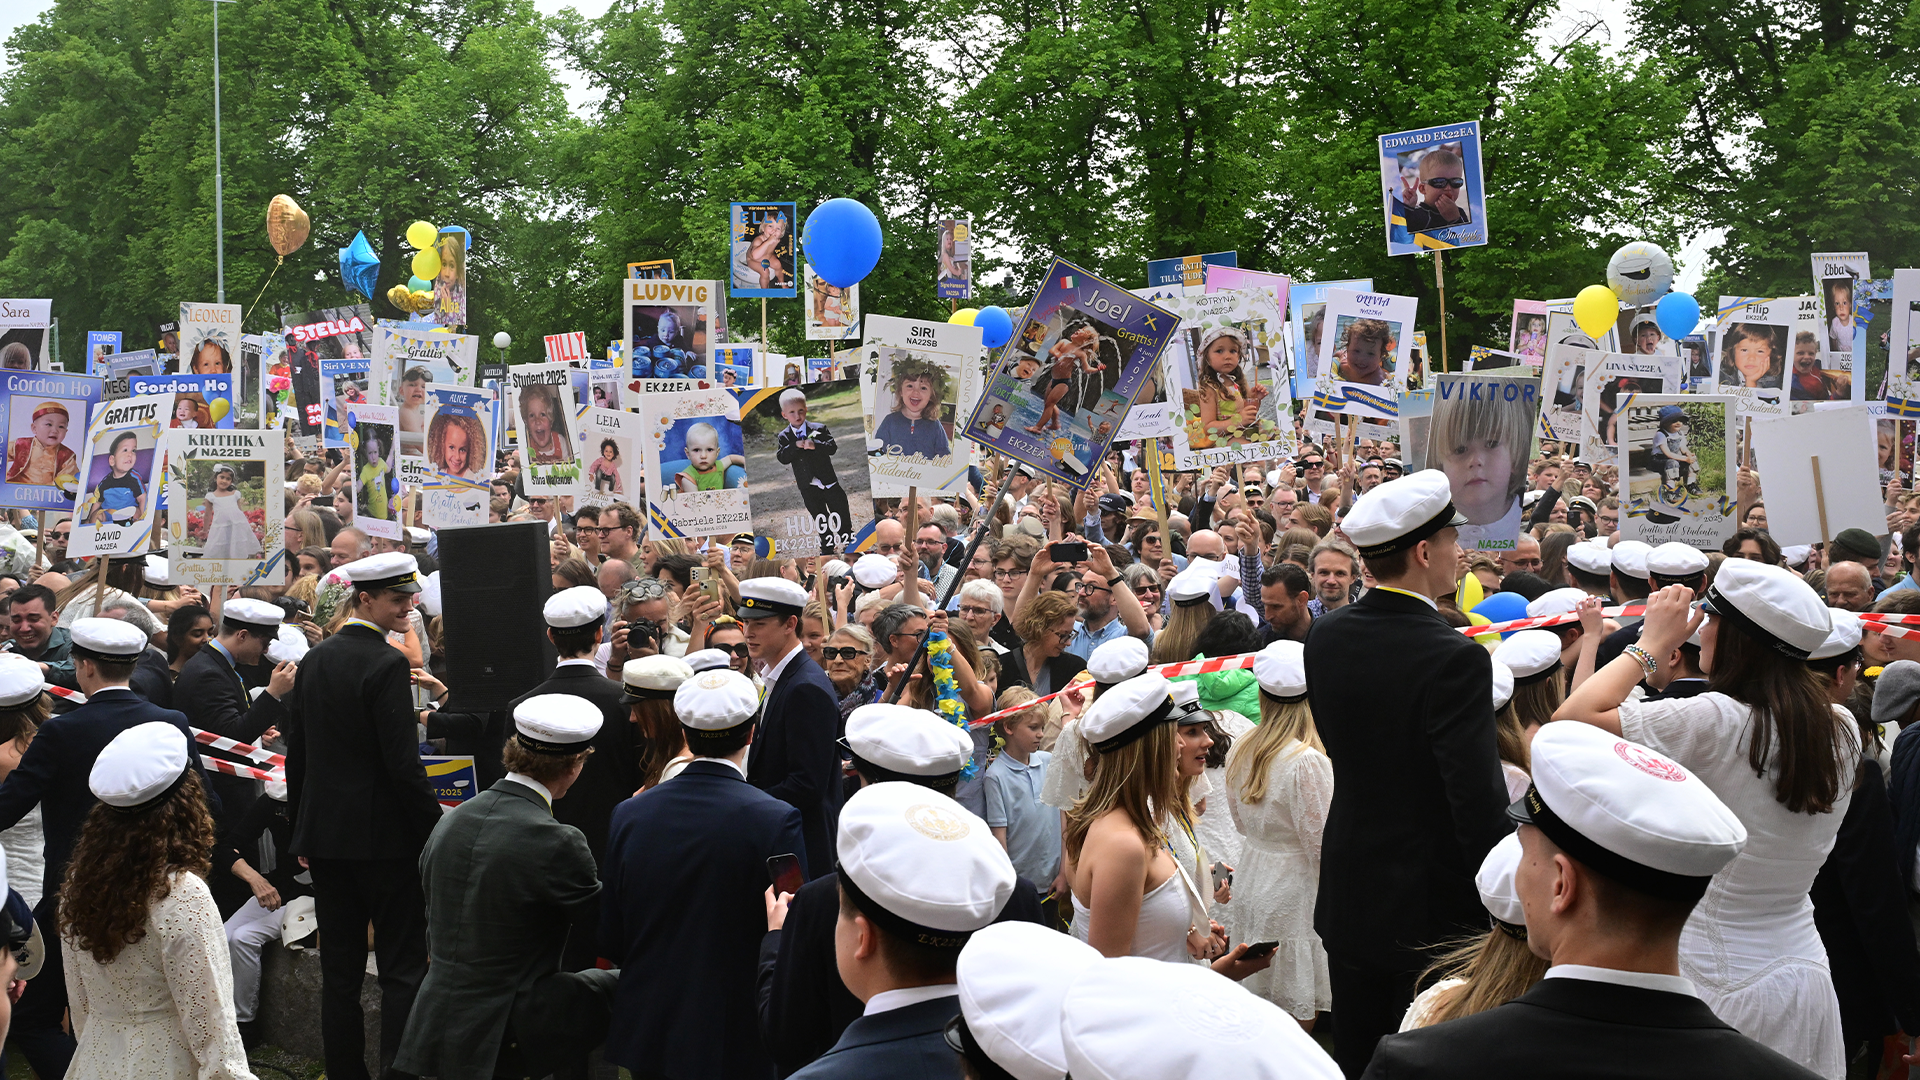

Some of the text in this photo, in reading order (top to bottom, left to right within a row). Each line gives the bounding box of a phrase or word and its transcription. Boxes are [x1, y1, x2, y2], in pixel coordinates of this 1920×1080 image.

[1384, 127, 1475, 149] EDWARD EK22EA
[739, 210, 788, 225] ELLA
[733, 223, 756, 236] 2025
[1438, 228, 1478, 241] Student
[1174, 261, 1207, 272] GRATTIS
[1824, 262, 1845, 276] Ebba
[1160, 271, 1207, 283] TILL STUDEN
[632, 283, 708, 303] LUDVIG
[440, 297, 460, 313] Alba
[1084, 289, 1132, 323] Joel
[1196, 295, 1236, 307] KOTRYNA
[1355, 294, 1391, 307] OLIVIA
[1, 301, 31, 318] Sara
[188, 308, 234, 324] LEONEL
[1203, 306, 1234, 317] NA22SA
[1745, 303, 1770, 315] Filip
[292, 316, 364, 341] STELLA
[910, 326, 935, 338] SIRI
[92, 333, 117, 342] TOMER
[906, 337, 938, 347] NA22SB
[1117, 327, 1158, 348] Grattis!
[240, 341, 263, 355] GRATTIS
[407, 345, 442, 359] Grattis
[545, 332, 586, 362] TILLY
[111, 356, 135, 364] GRATTIS
[323, 362, 339, 370] Siri
[341, 362, 357, 370] V-E
[484, 368, 503, 376] MATILDA
[1605, 362, 1662, 373] LINA SA22EA
[512, 369, 567, 388] Student 2025
[963, 355, 975, 403] 2025
[1121, 356, 1145, 394] 2025
[7, 375, 92, 397] Gordon Ho
[134, 379, 228, 394] Gordon Ho
[645, 382, 691, 392] EK22EA
[997, 374, 1023, 393] BUONA
[1717, 380, 1753, 398] Grattis
[449, 393, 467, 404] ALICE
[1440, 381, 1536, 402] VIKTOR
[104, 403, 158, 425] GRATTIS
[1738, 399, 1782, 415] Studenten
[595, 414, 621, 429] LEIA
[1135, 408, 1162, 421] Leah
[1553, 426, 1575, 436] SOFIA
[188, 434, 265, 447] KRITHIKA
[201, 448, 251, 457] NA22EB
[1007, 436, 1046, 460] EK22EA
[883, 443, 928, 468] Grattis
[1183, 447, 1256, 468] STUDENT
[1261, 444, 1290, 458] 2025
[868, 457, 922, 480] Studenten
[531, 475, 545, 485] Stina
[15, 487, 65, 503] GRATTIS
[430, 489, 461, 514] Grattis
[671, 511, 750, 528] Gabriele EK22EA
[785, 511, 842, 537] HUGO
[1703, 515, 1723, 523] 2025
[94, 531, 121, 542] DAVID
[1638, 523, 1719, 537] Grattis till Studenten
[94, 542, 118, 551] NA22EA
[774, 532, 857, 552] EK22EA 2025
[1477, 539, 1516, 550] NA22SA
[176, 562, 205, 576] Grattis
[193, 573, 234, 584] Studenten
[440, 788, 463, 796] 2025
[917, 933, 966, 947] EK22E
